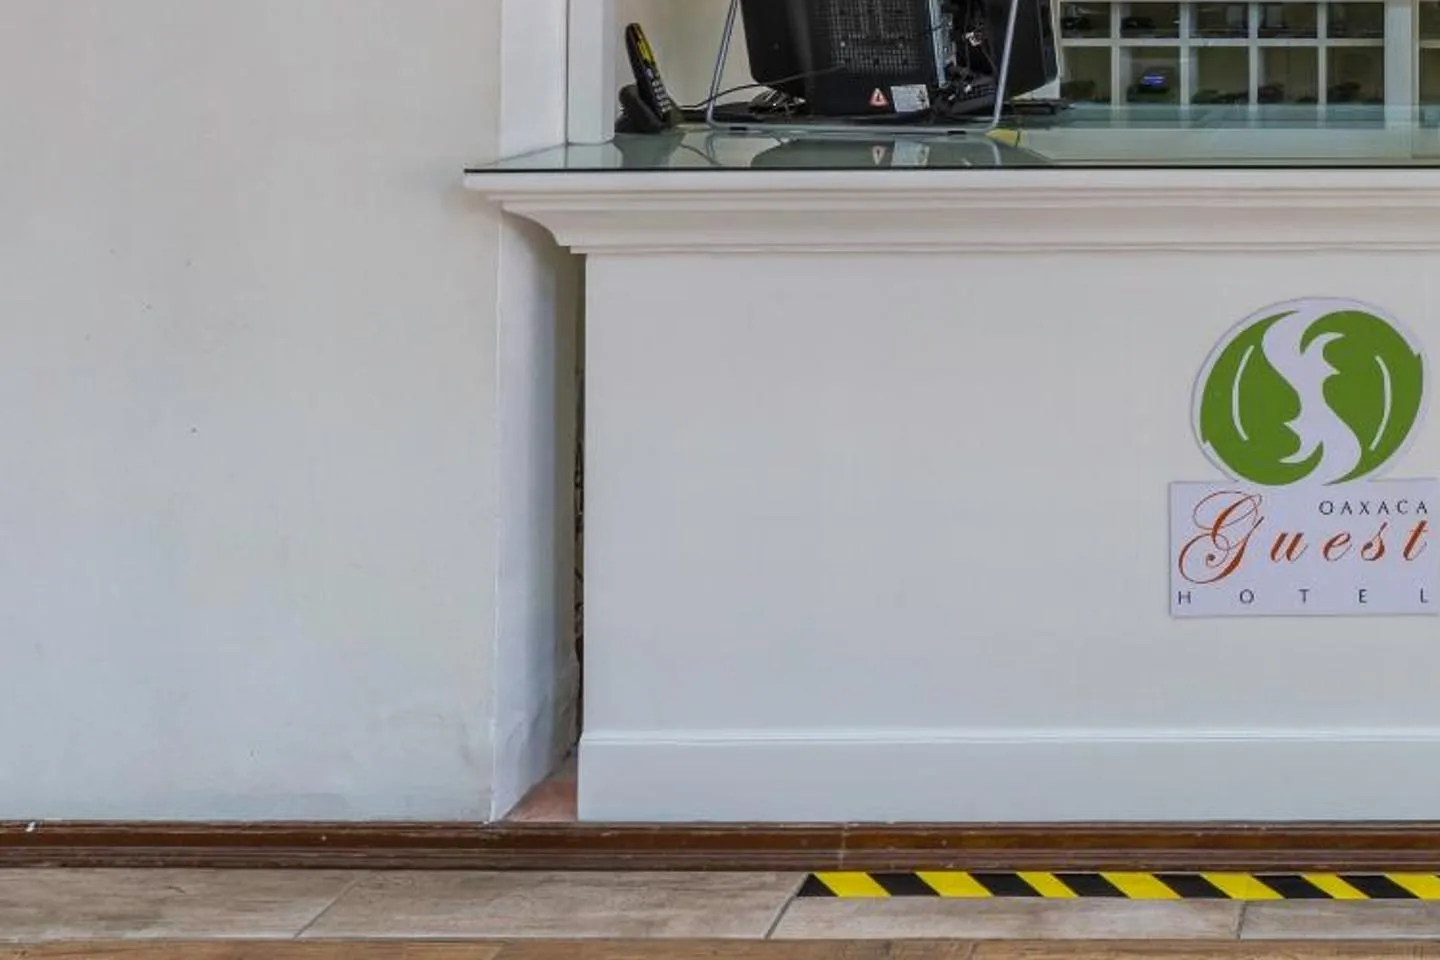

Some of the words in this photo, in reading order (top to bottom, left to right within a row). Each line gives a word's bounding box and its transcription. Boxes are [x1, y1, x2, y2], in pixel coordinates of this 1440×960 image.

[1319, 500, 1428, 515] OAXACA
[1178, 490, 1429, 584] Guest
[1178, 589, 1428, 604] HOTEL
